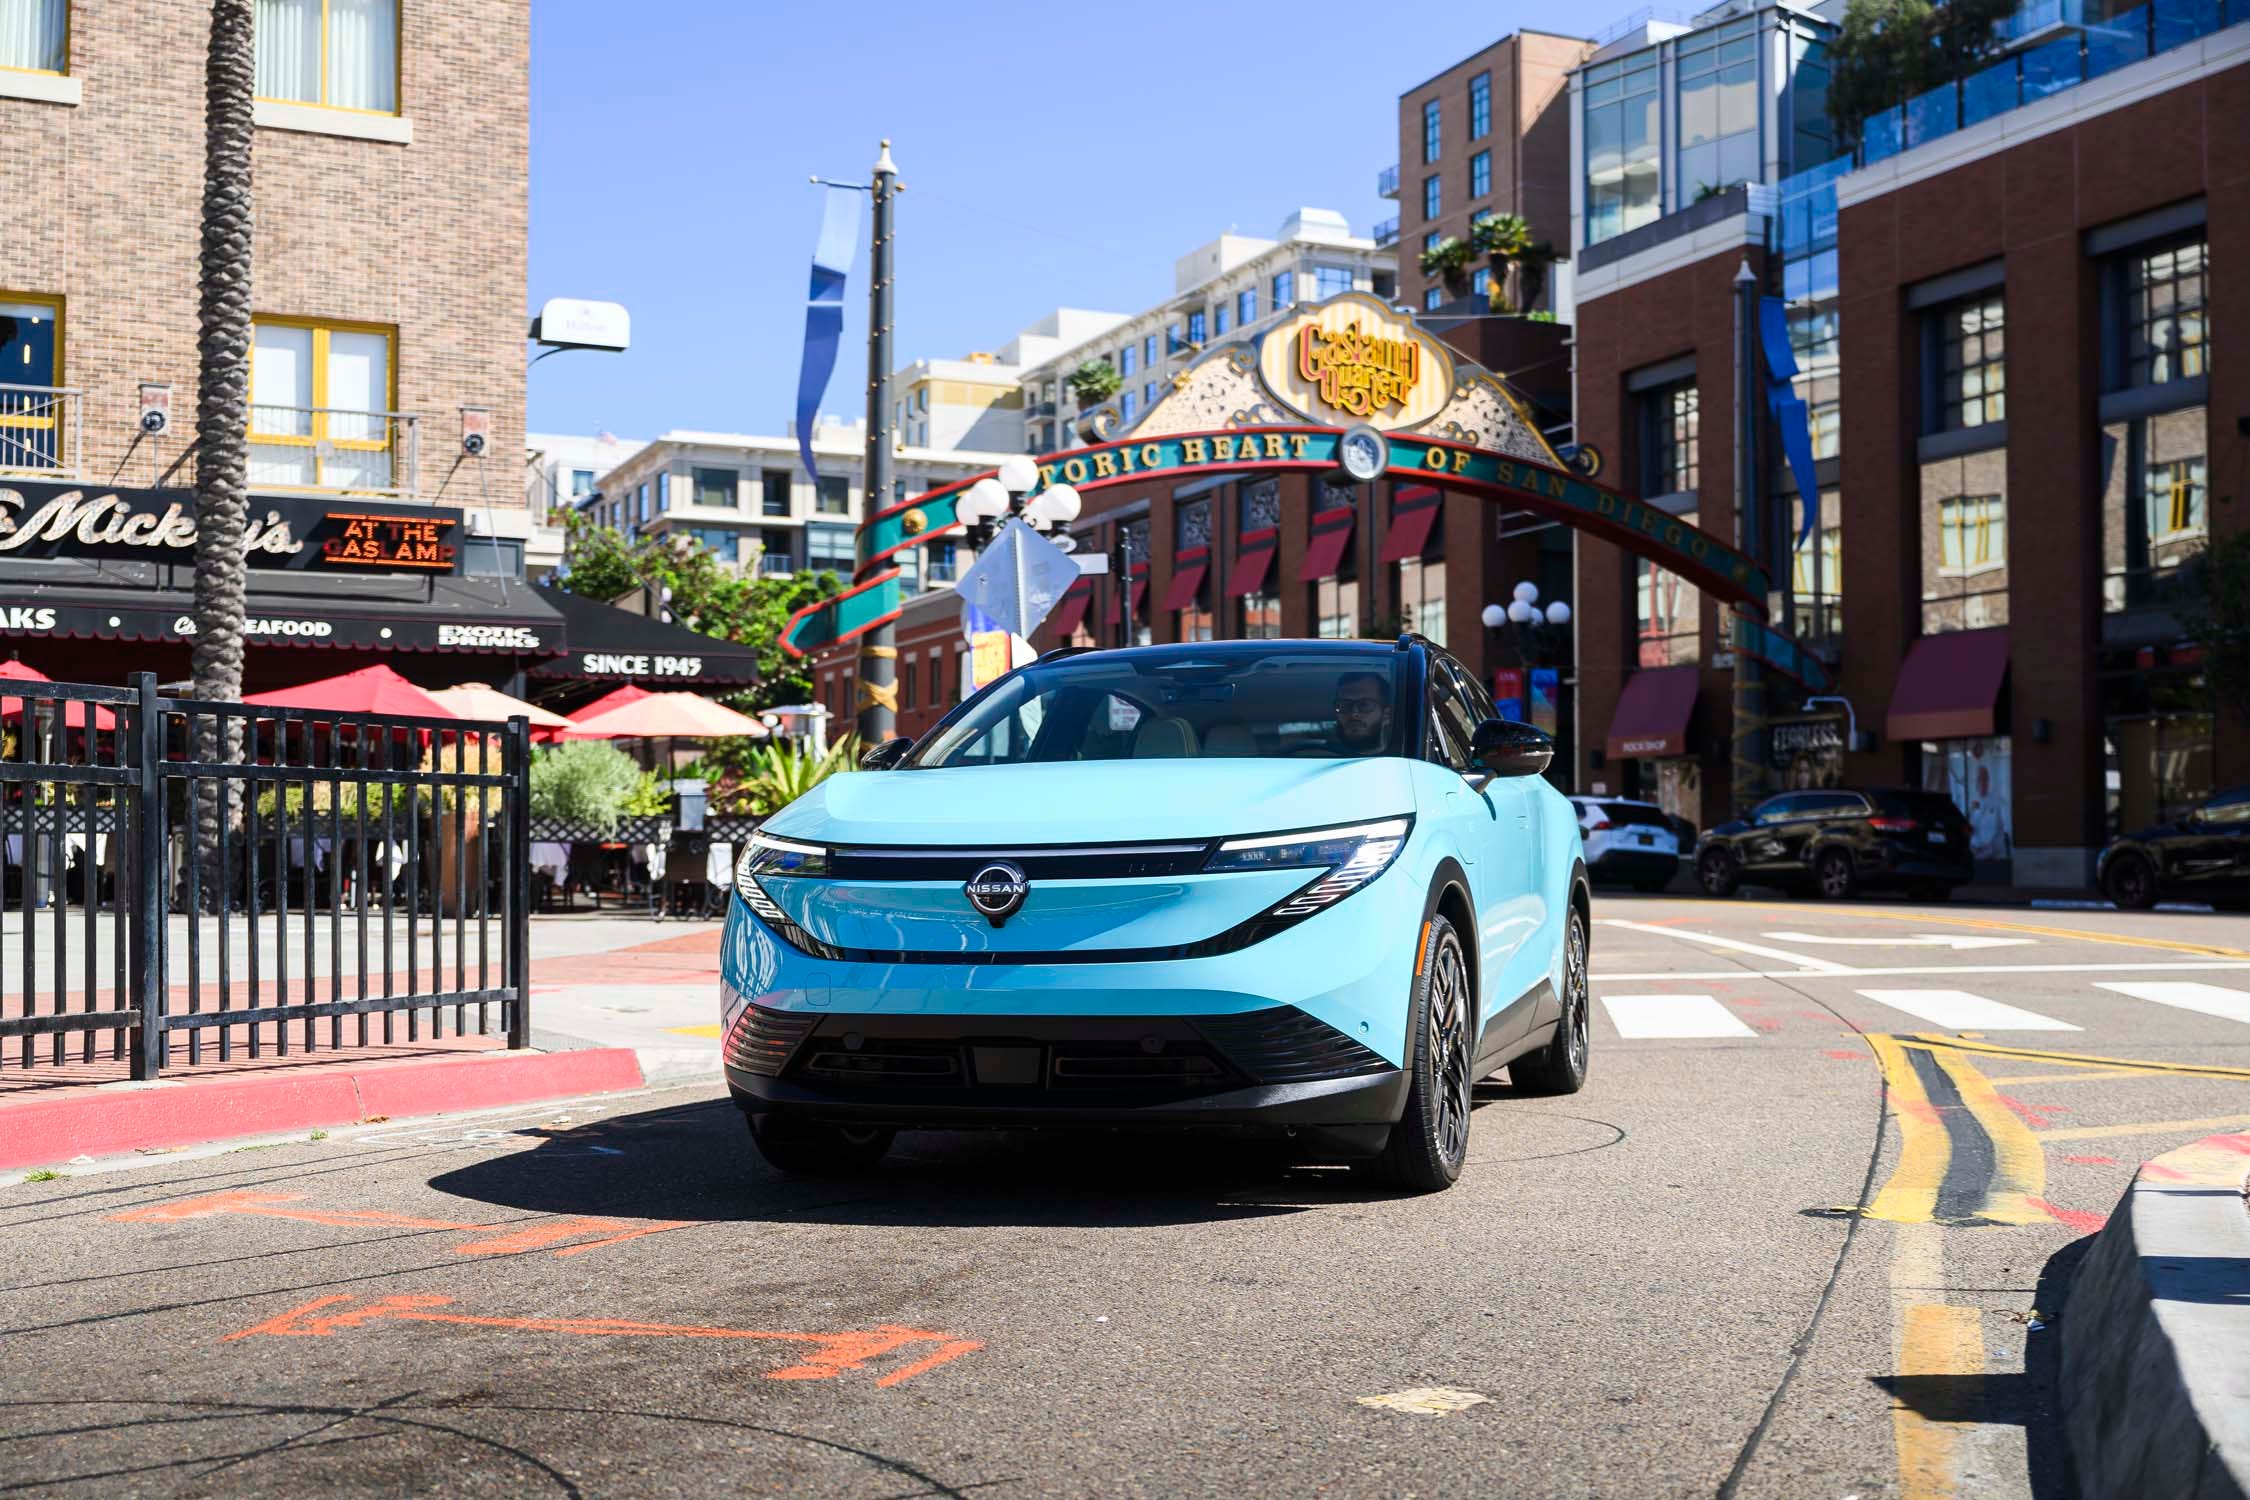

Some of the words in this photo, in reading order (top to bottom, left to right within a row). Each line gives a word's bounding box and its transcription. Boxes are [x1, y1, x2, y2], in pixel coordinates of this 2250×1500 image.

[1300, 320, 1420, 385] Gaslamp
[1038, 444, 1161, 490] TORIC
[1181, 434, 1310, 463] HEART
[1426, 446, 1471, 473] OF
[1497, 462, 1569, 497] SAN
[1598, 492, 1709, 557] DIEGO
[344, 520, 379, 538] AT
[386, 523, 438, 541] THE
[241, 618, 332, 637] EAFOOD
[438, 624, 532, 639] EXOTIC
[438, 635, 540, 648] DRINKS
[583, 654, 649, 675] SINCE
[654, 656, 702, 677] 1945
[967, 884, 1024, 893] NISSAN
